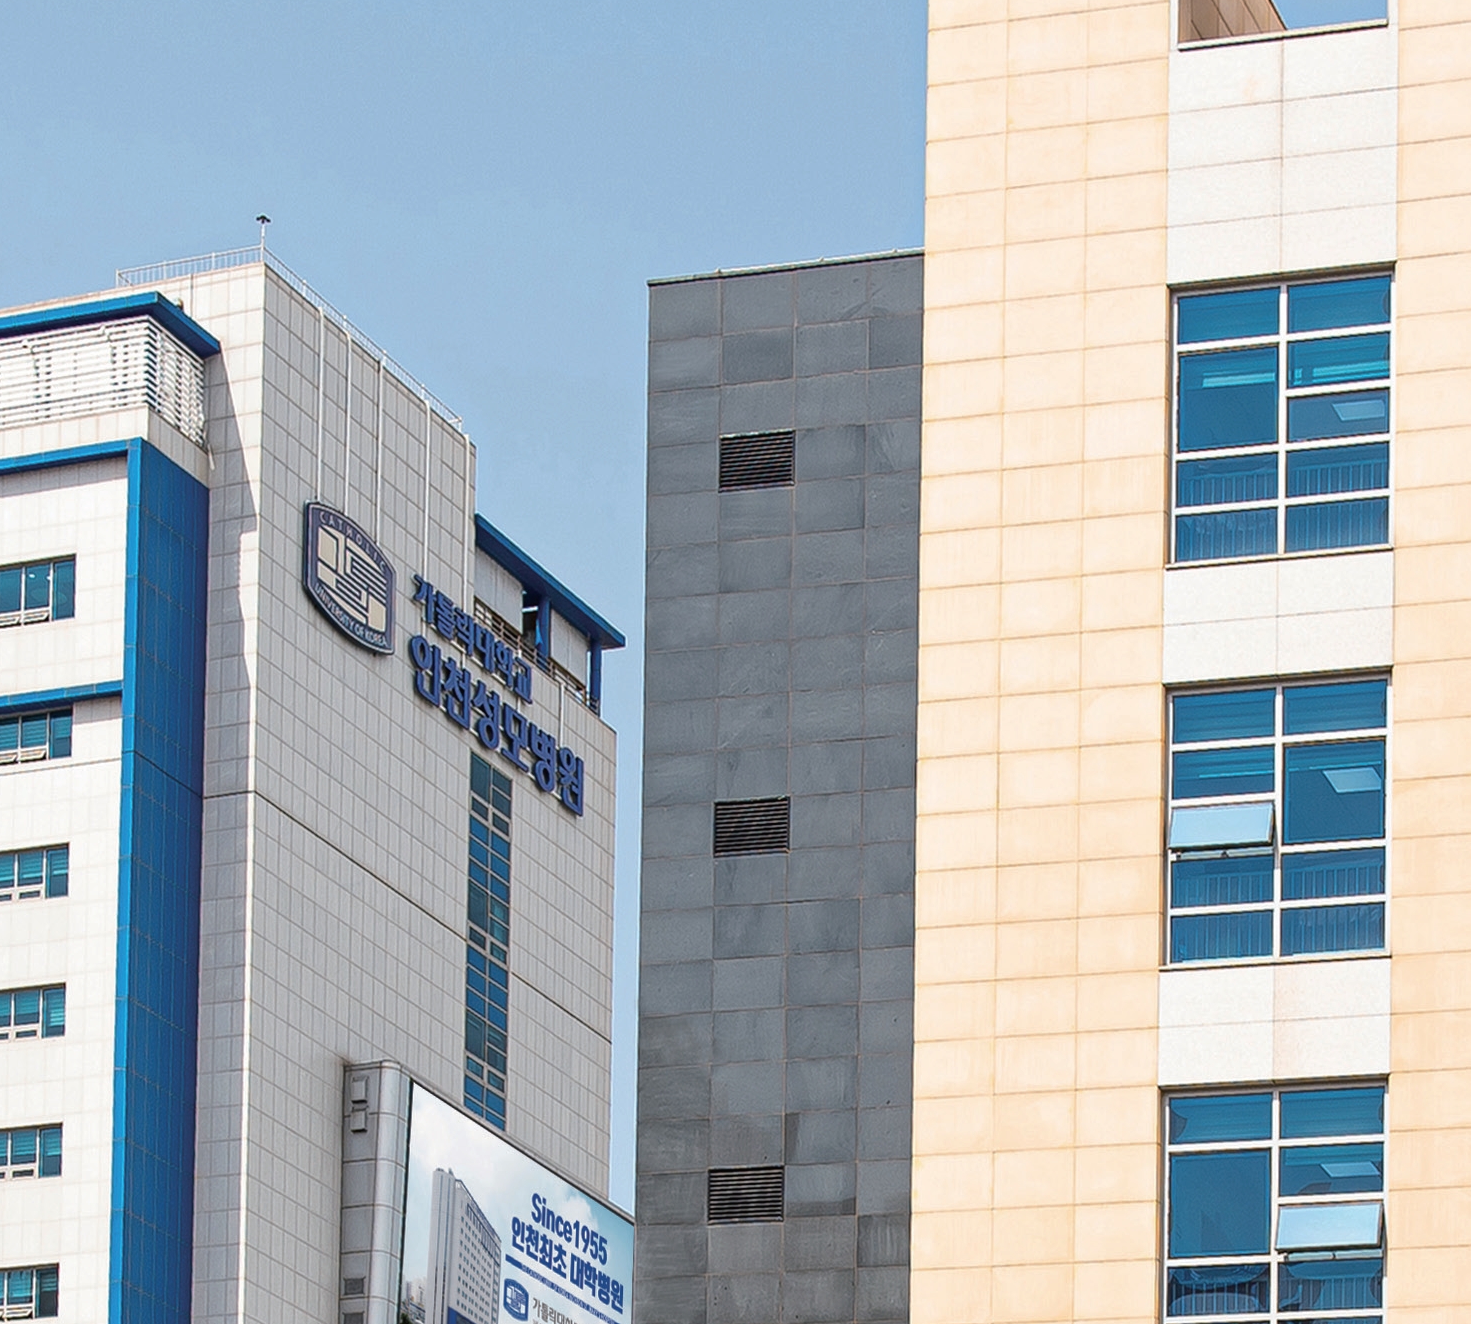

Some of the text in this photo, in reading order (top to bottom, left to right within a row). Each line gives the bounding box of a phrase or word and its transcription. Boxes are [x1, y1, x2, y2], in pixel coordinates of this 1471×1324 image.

[319, 511, 386, 573] CATHOLIC
[314, 582, 355, 630] UNIVERSITY
[412, 575, 533, 704] 가톨릭대학교
[409, 634, 584, 817] 인천성모병원
[511, 1216, 567, 1279] 인천최초
[570, 1252, 624, 1315] 대학병원
